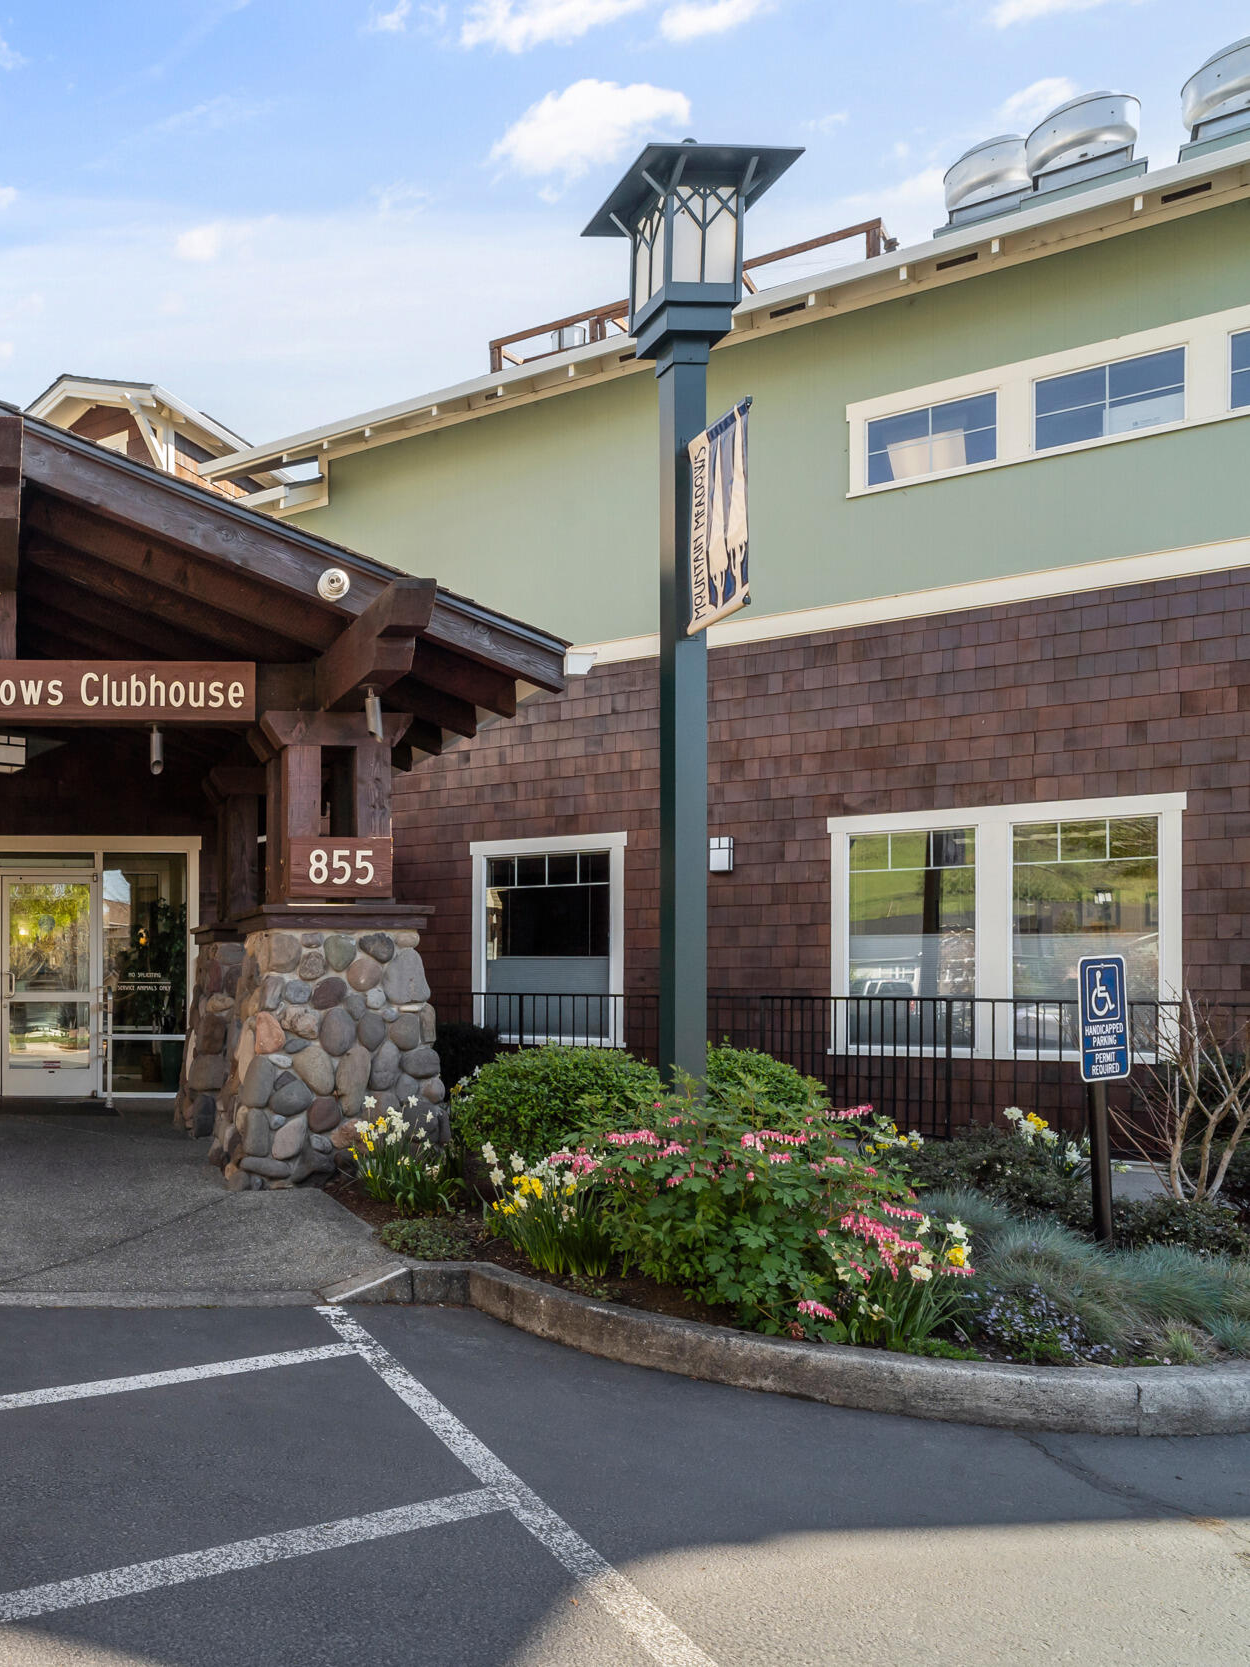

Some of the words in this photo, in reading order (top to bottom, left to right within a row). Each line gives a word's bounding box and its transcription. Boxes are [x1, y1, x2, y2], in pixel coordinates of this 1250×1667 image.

[694, 446, 707, 531] MEADOWS
[694, 534, 707, 621] MOUNTAIN
[81, 672, 246, 708] Clubhouse
[308, 849, 374, 885] 855
[1084, 1022, 1124, 1036] HANDICAPPED
[1092, 1035, 1117, 1047] PARKING
[1091, 1063, 1120, 1076] REQUIRED
[1094, 1051, 1116, 1064] PERMIT
